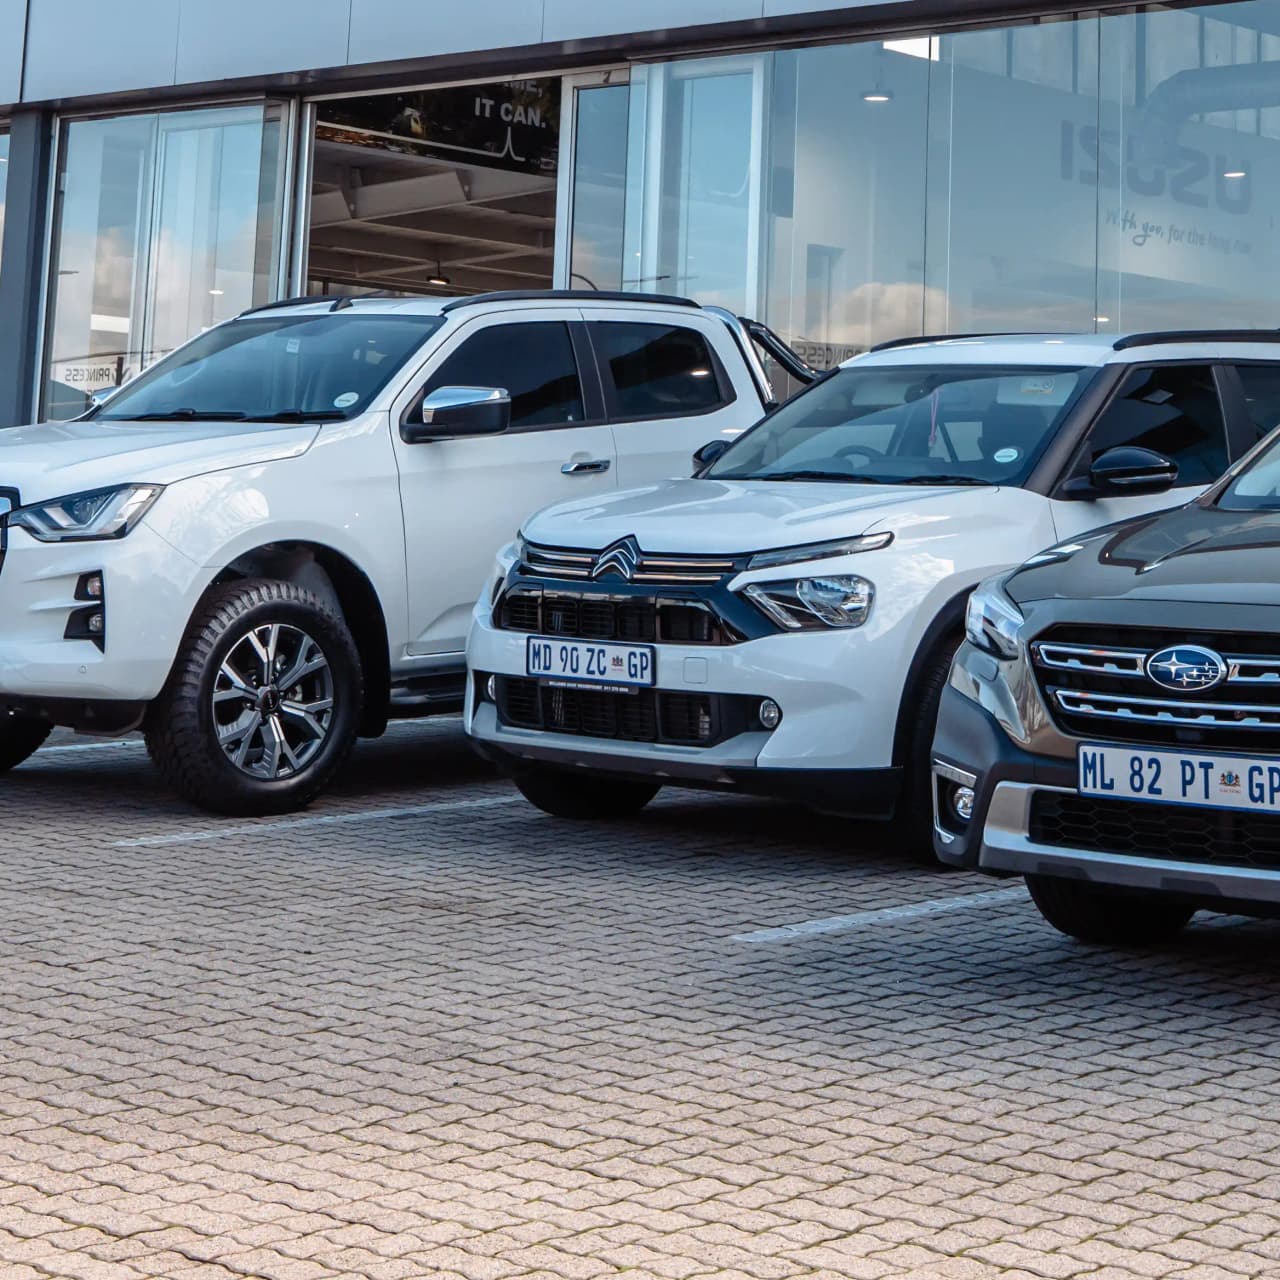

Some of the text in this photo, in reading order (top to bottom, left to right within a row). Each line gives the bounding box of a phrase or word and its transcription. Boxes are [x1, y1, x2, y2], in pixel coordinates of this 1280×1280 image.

[474, 97, 546, 128] IT CAN.
[1060, 120, 1252, 215] ISUZU
[532, 643, 649, 679] MD 90 ZC GP
[1082, 751, 1114, 791] ML
[1129, 756, 1162, 795] 82
[1180, 759, 1214, 800] PT
